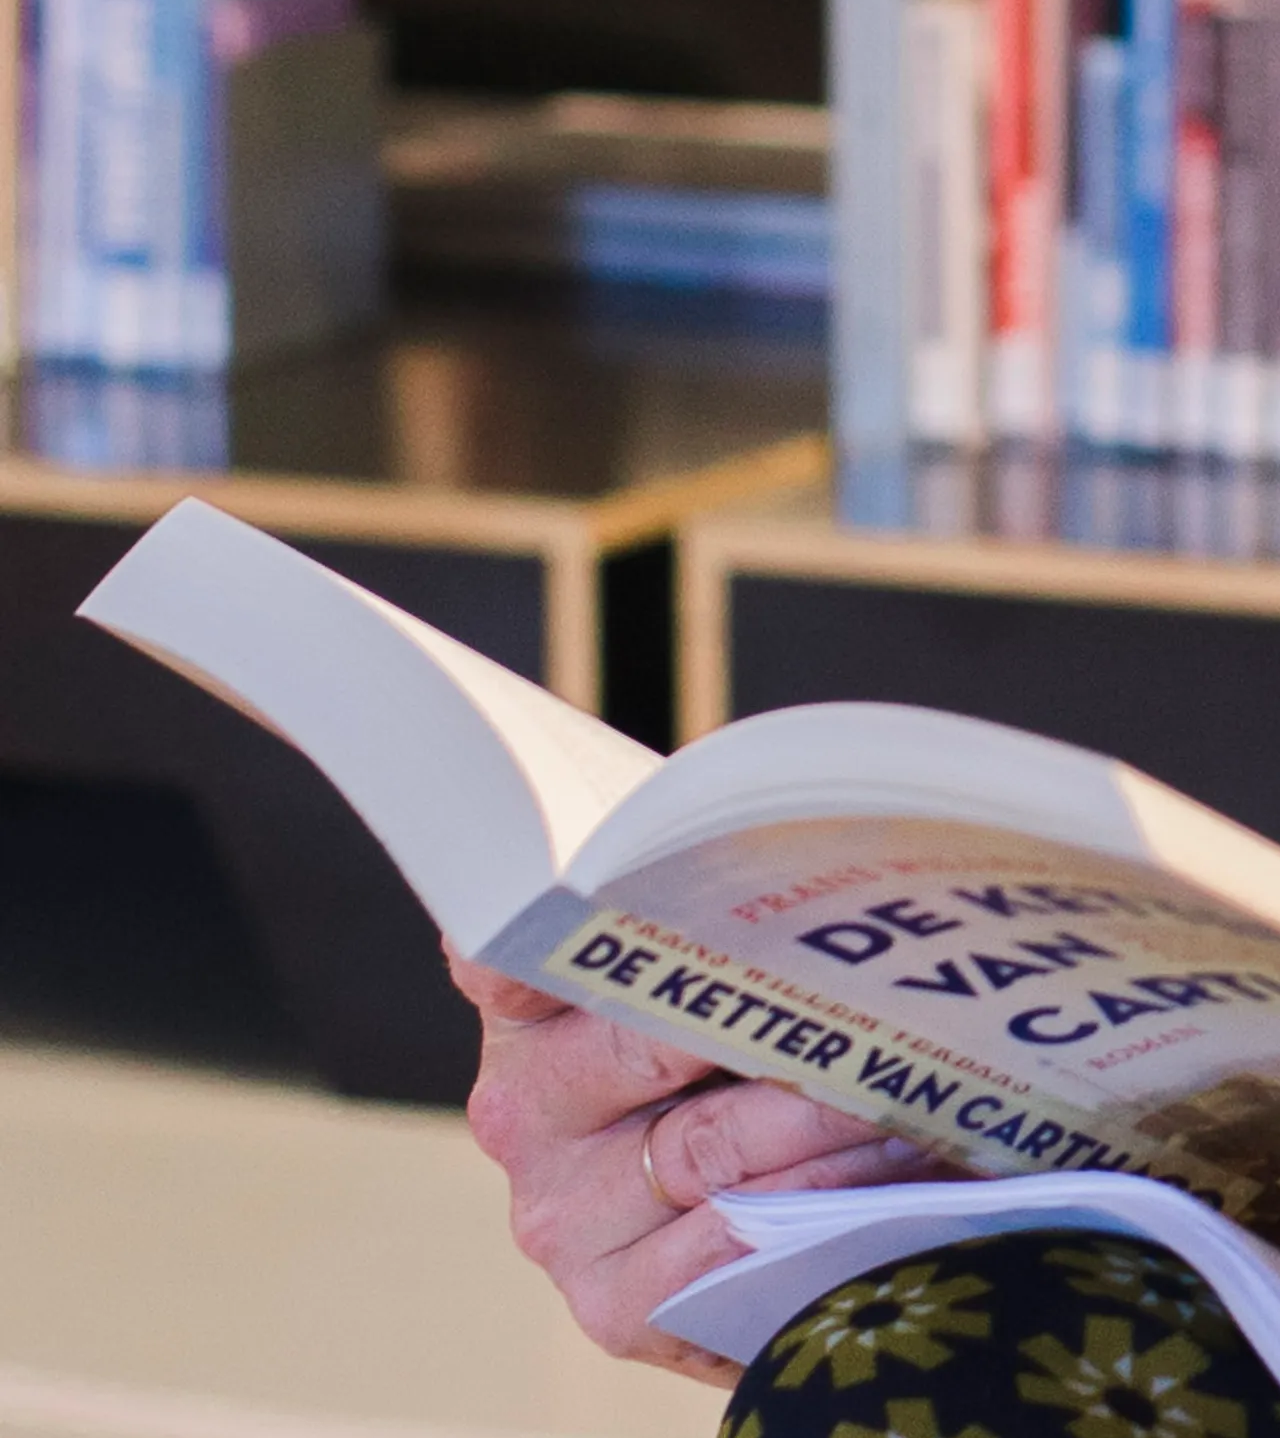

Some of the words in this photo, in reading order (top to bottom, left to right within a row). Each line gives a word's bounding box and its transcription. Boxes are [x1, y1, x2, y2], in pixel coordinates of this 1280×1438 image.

[795, 898, 965, 967] DE
[892, 930, 1119, 998] VAN
[570, 932, 660, 986] DE
[650, 965, 853, 1070] KETTER
[856, 1045, 962, 1114] VAN
[955, 1095, 1224, 1212] CARTH
